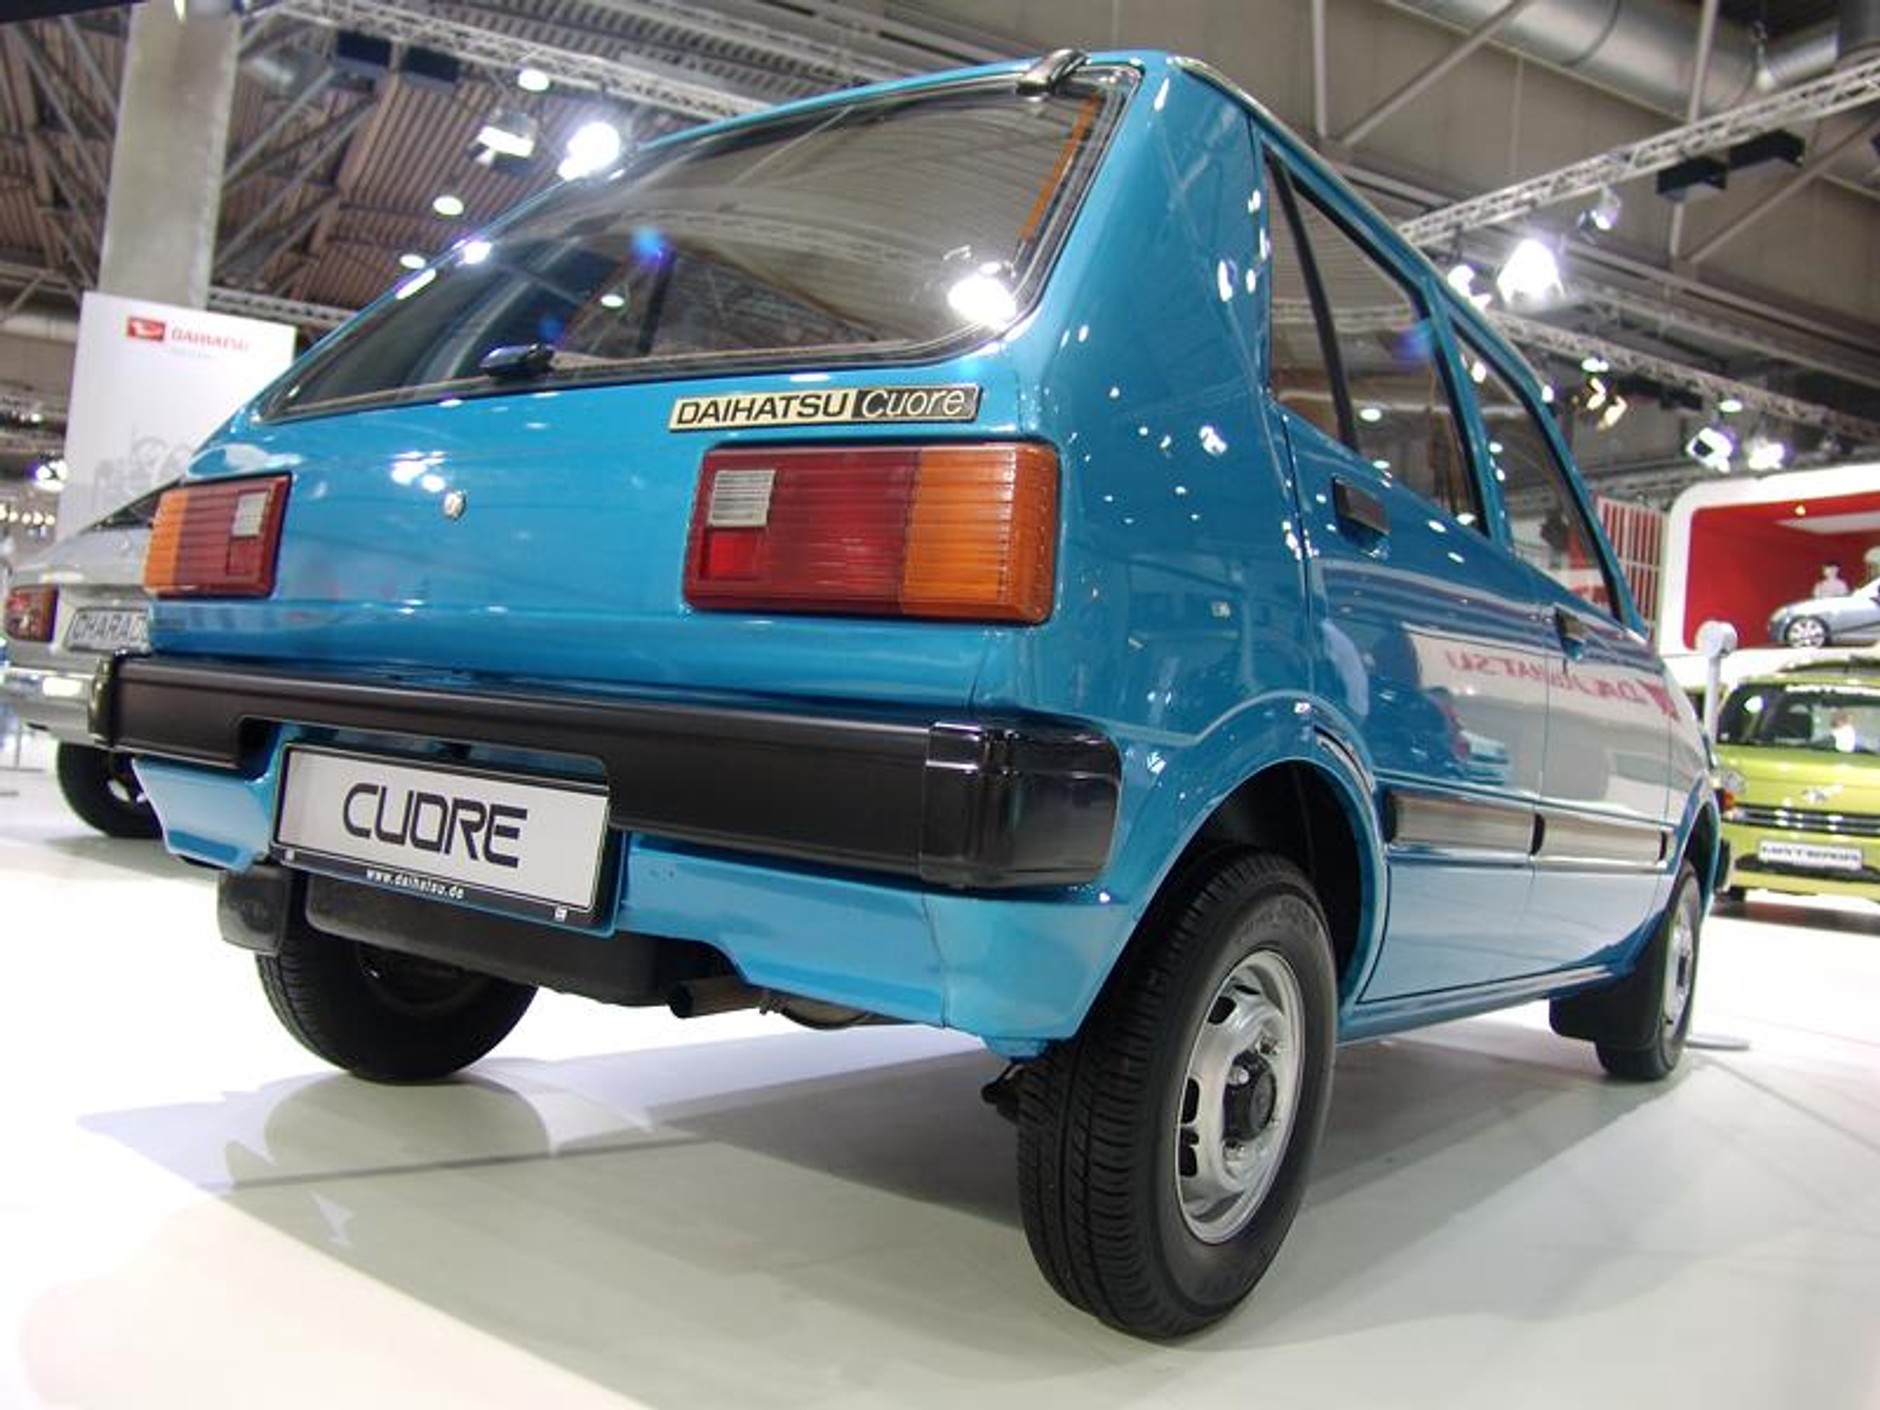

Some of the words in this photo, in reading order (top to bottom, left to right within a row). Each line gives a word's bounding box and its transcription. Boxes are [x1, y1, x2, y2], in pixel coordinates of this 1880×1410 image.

[676, 391, 849, 425] DAIHATSU
[860, 386, 965, 420] Cuore
[72, 613, 148, 644] CHARAD
[342, 782, 528, 869] CUORE
[366, 868, 465, 900] www.daihatsu.de
